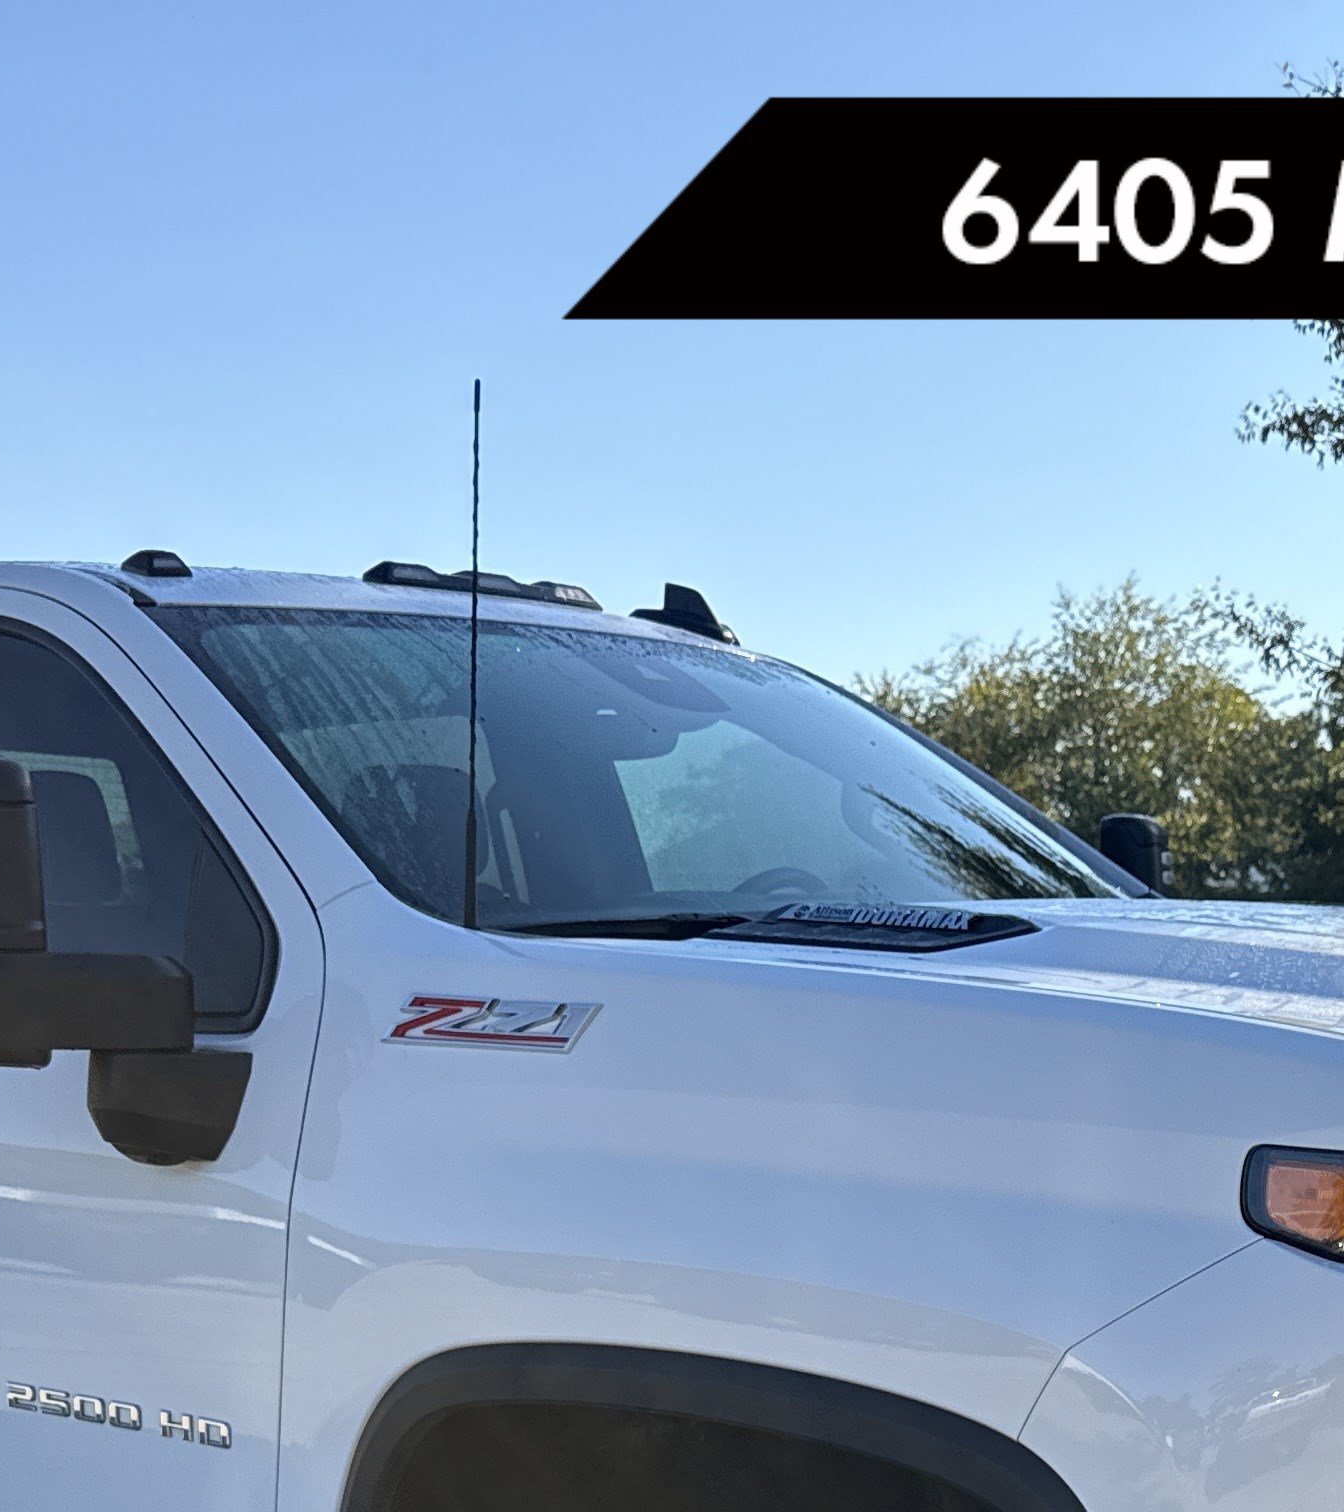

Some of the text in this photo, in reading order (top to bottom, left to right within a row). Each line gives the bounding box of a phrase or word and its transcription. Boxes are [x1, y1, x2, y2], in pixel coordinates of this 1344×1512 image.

[853, 907, 970, 931] DURAMAX
[380, 992, 604, 1055] Z71
[6, 1380, 233, 1450] 2500 HD
